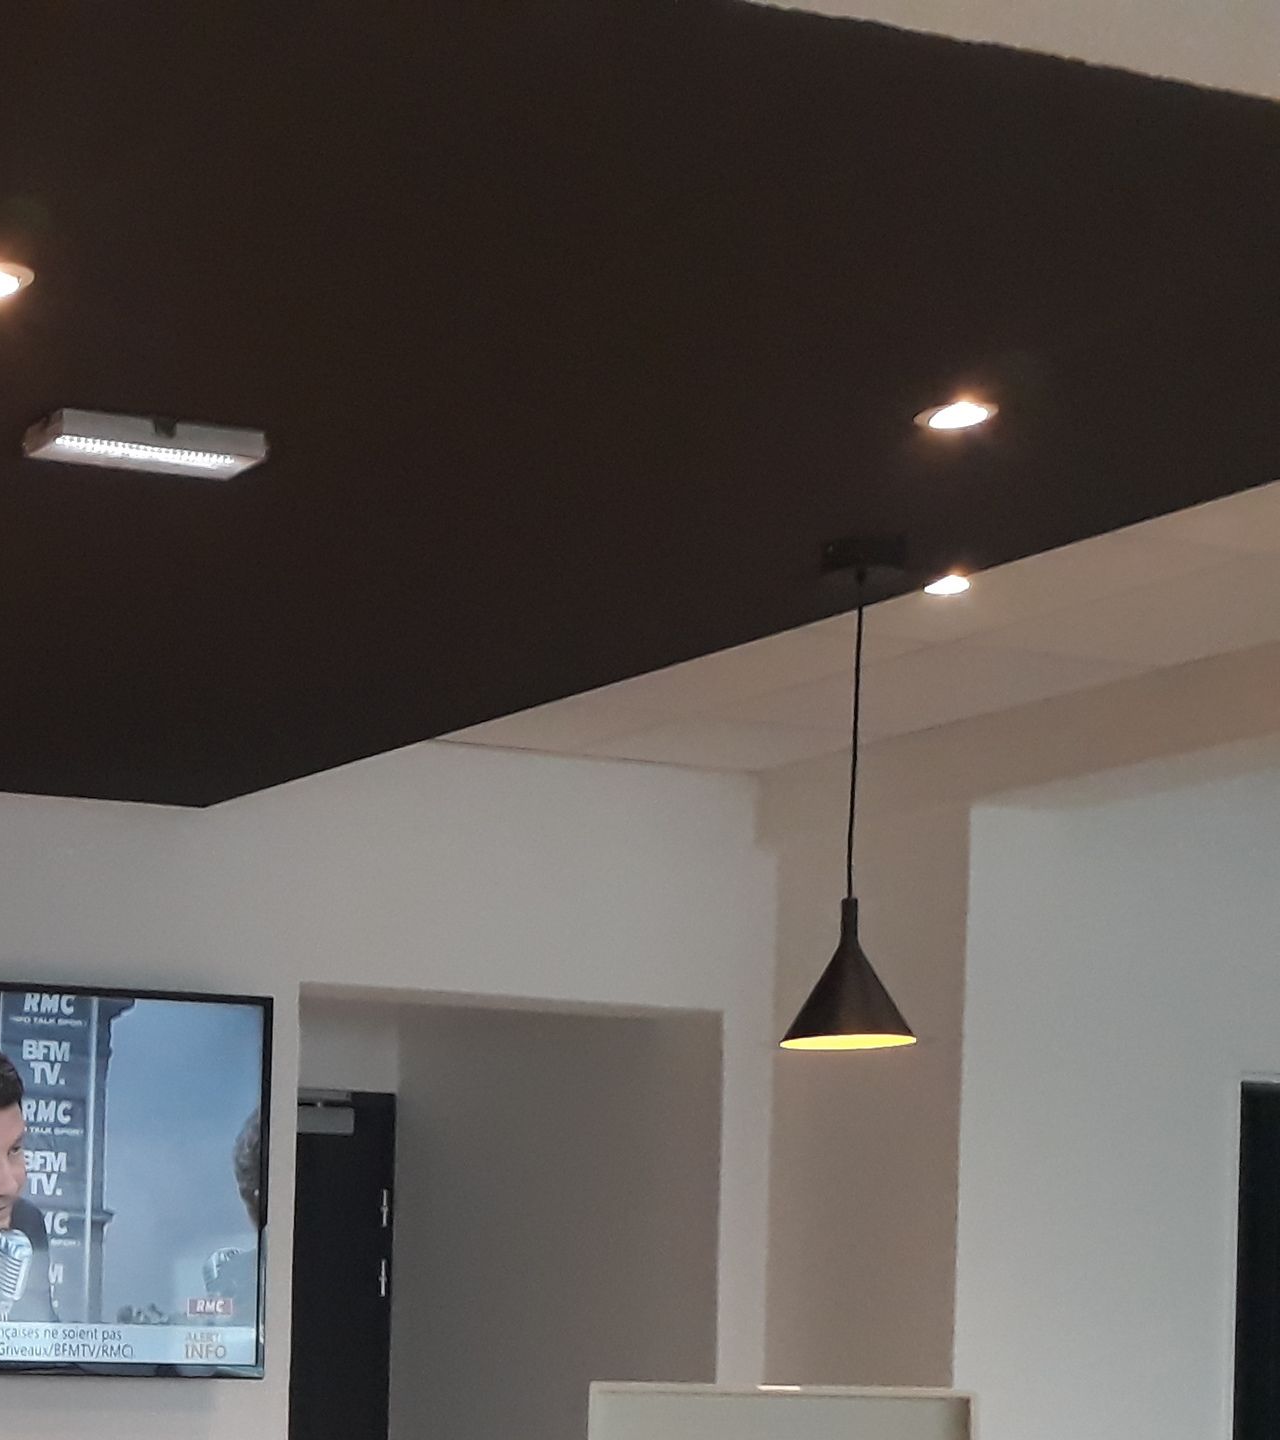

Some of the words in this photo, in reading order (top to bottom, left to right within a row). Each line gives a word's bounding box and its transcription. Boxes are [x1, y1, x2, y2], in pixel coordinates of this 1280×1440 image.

[24, 993, 75, 1015] RMC
[22, 1039, 71, 1062] BFM
[22, 1099, 73, 1124] RMC
[196, 1299, 225, 1313] RMC
[44, 1328, 58, 1338] ne
[62, 1326, 98, 1341] soient
[102, 1328, 122, 1342] pas
[185, 1344, 226, 1359] INFO
